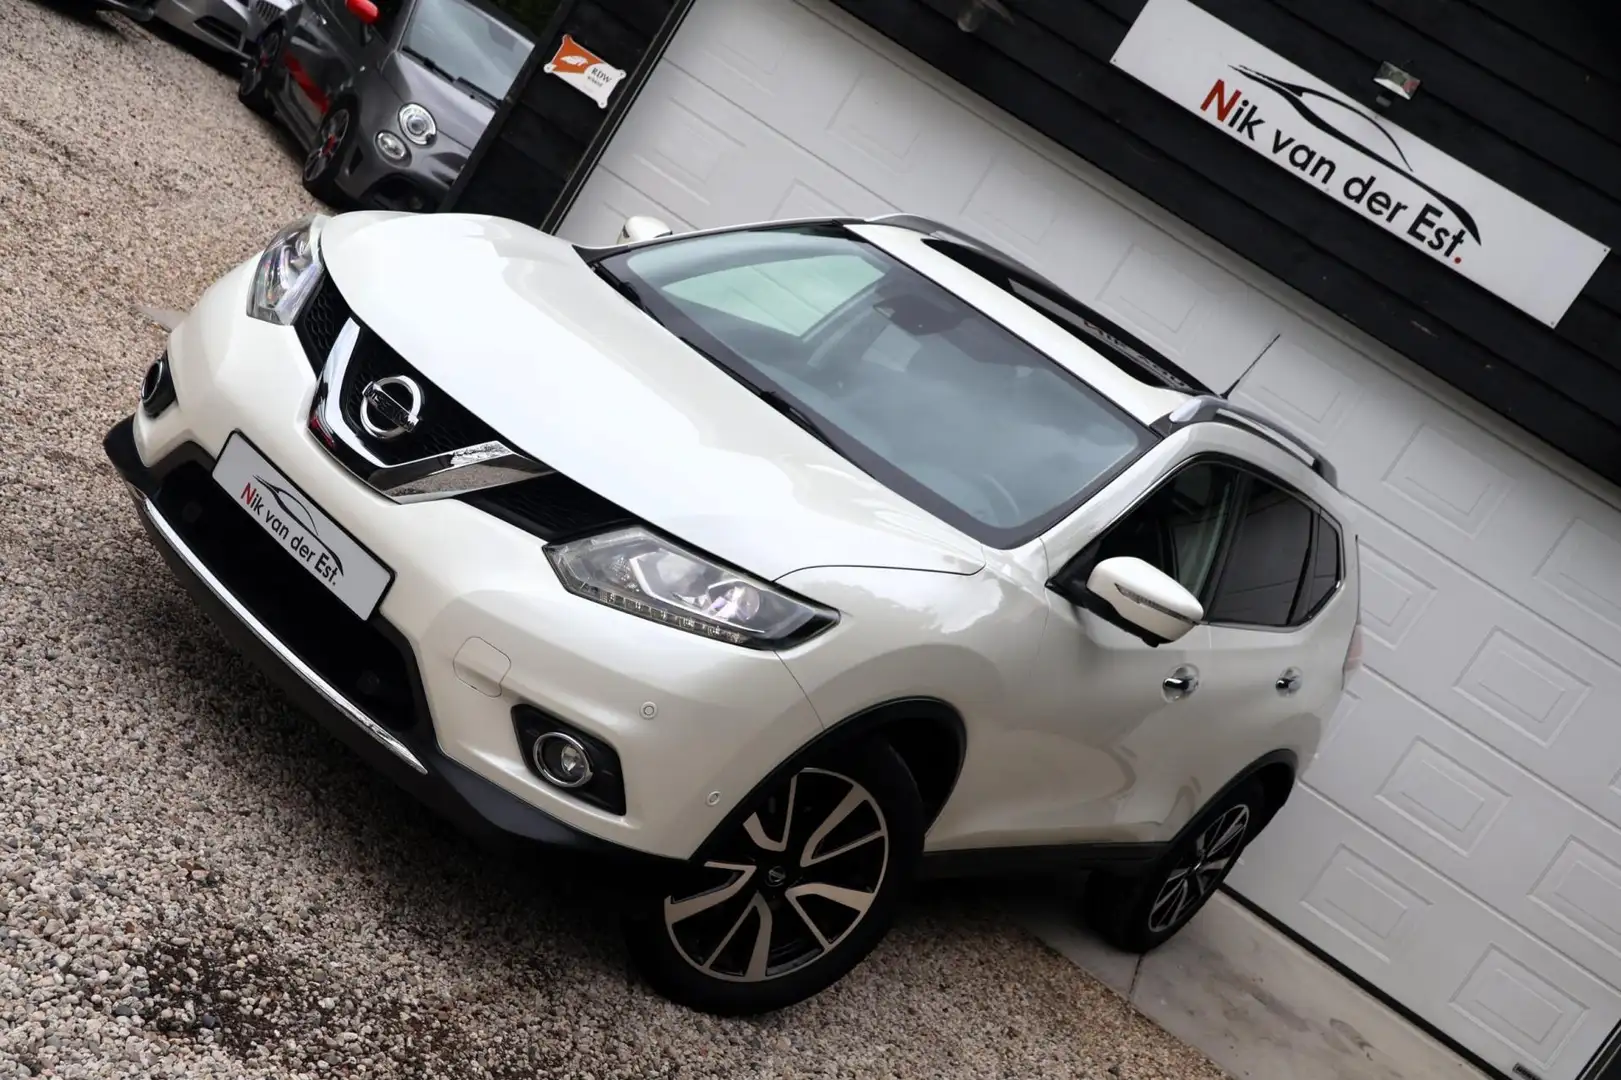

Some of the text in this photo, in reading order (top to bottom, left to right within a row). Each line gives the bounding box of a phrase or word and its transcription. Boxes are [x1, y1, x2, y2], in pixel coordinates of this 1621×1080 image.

[591, 67, 613, 83] RDW
[1200, 79, 1466, 264] Nik van der Est.
[240, 482, 338, 587] Nik van der Est.
